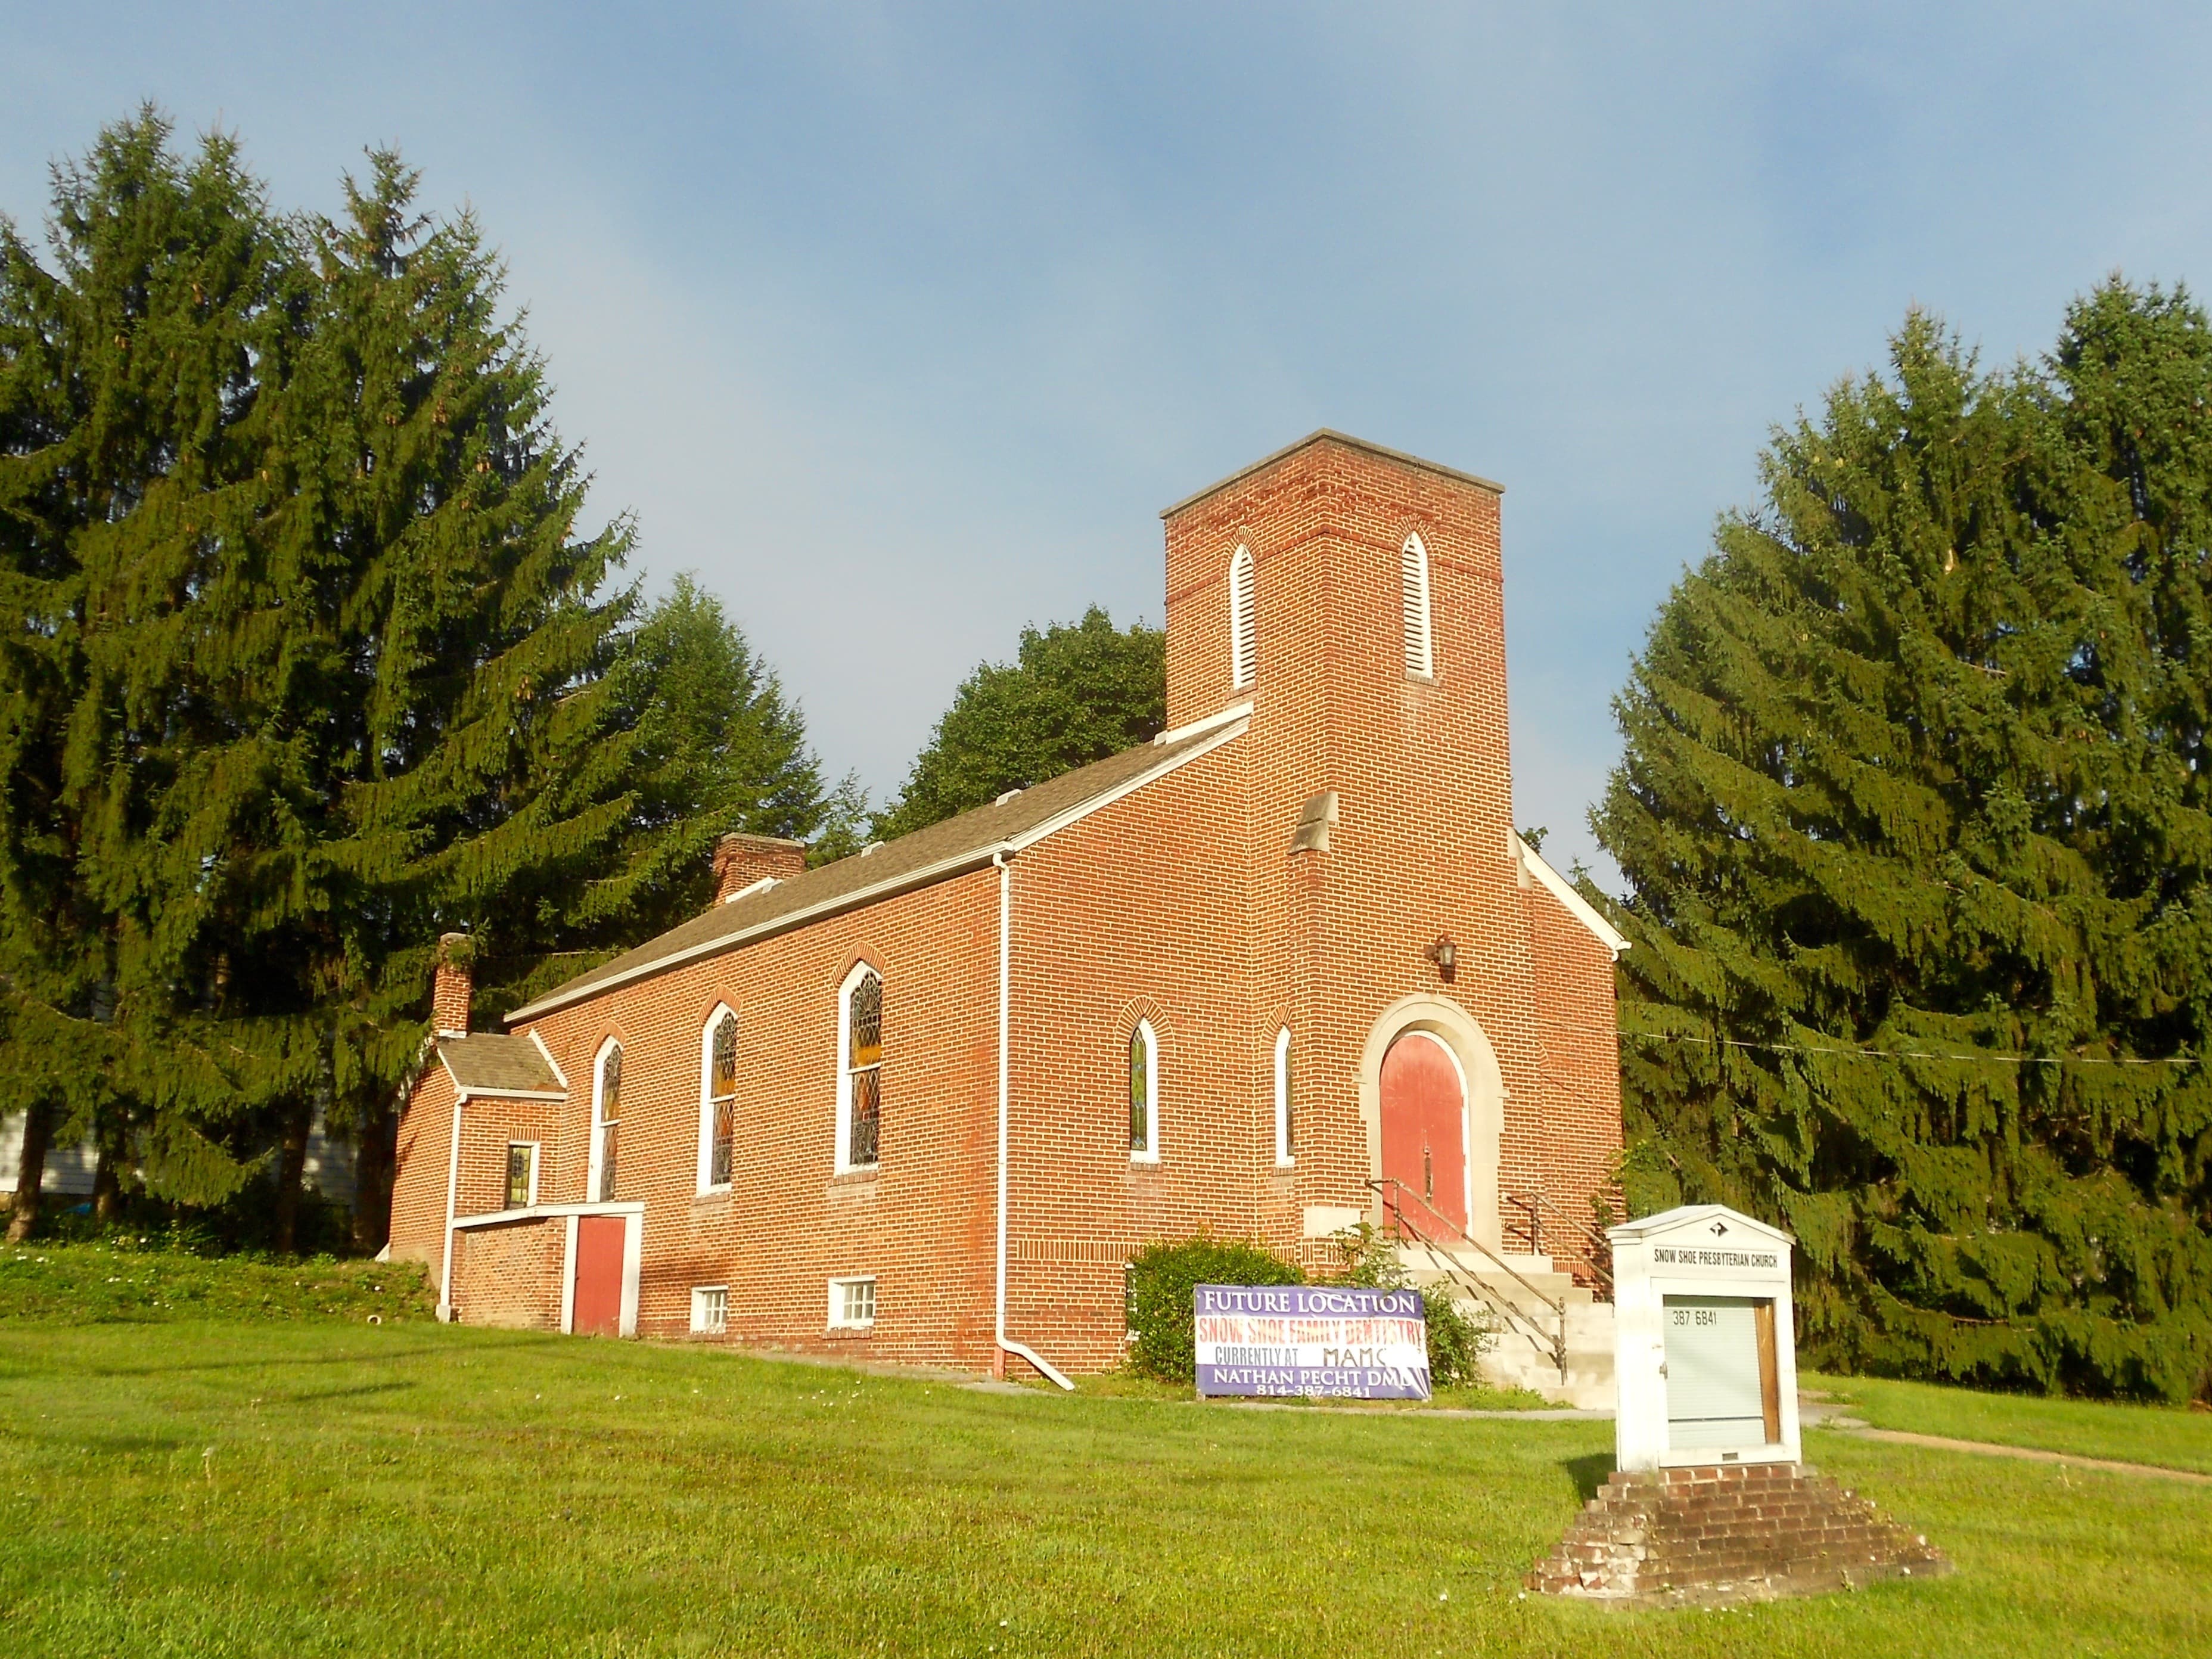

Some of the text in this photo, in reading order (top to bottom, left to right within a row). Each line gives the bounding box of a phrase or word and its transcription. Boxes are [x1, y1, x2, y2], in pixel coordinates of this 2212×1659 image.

[1654, 1248, 1778, 1269] SNOW SHOE PRESBYTERIAN CHURCH
[1204, 1290, 1416, 1315] FUTURE LOCATION
[1673, 1310, 1717, 1325] 387 6841
[1199, 1317, 1422, 1347] SNOW SHOE FAMILY DENTISTRY
[1214, 1346, 1282, 1366] CURRENTLY
[1284, 1348, 1299, 1367] AT
[1213, 1368, 1294, 1384] NATHAN
[1301, 1370, 1362, 1386] PECHT
[1256, 1384, 1371, 1397] 814-387-6841
